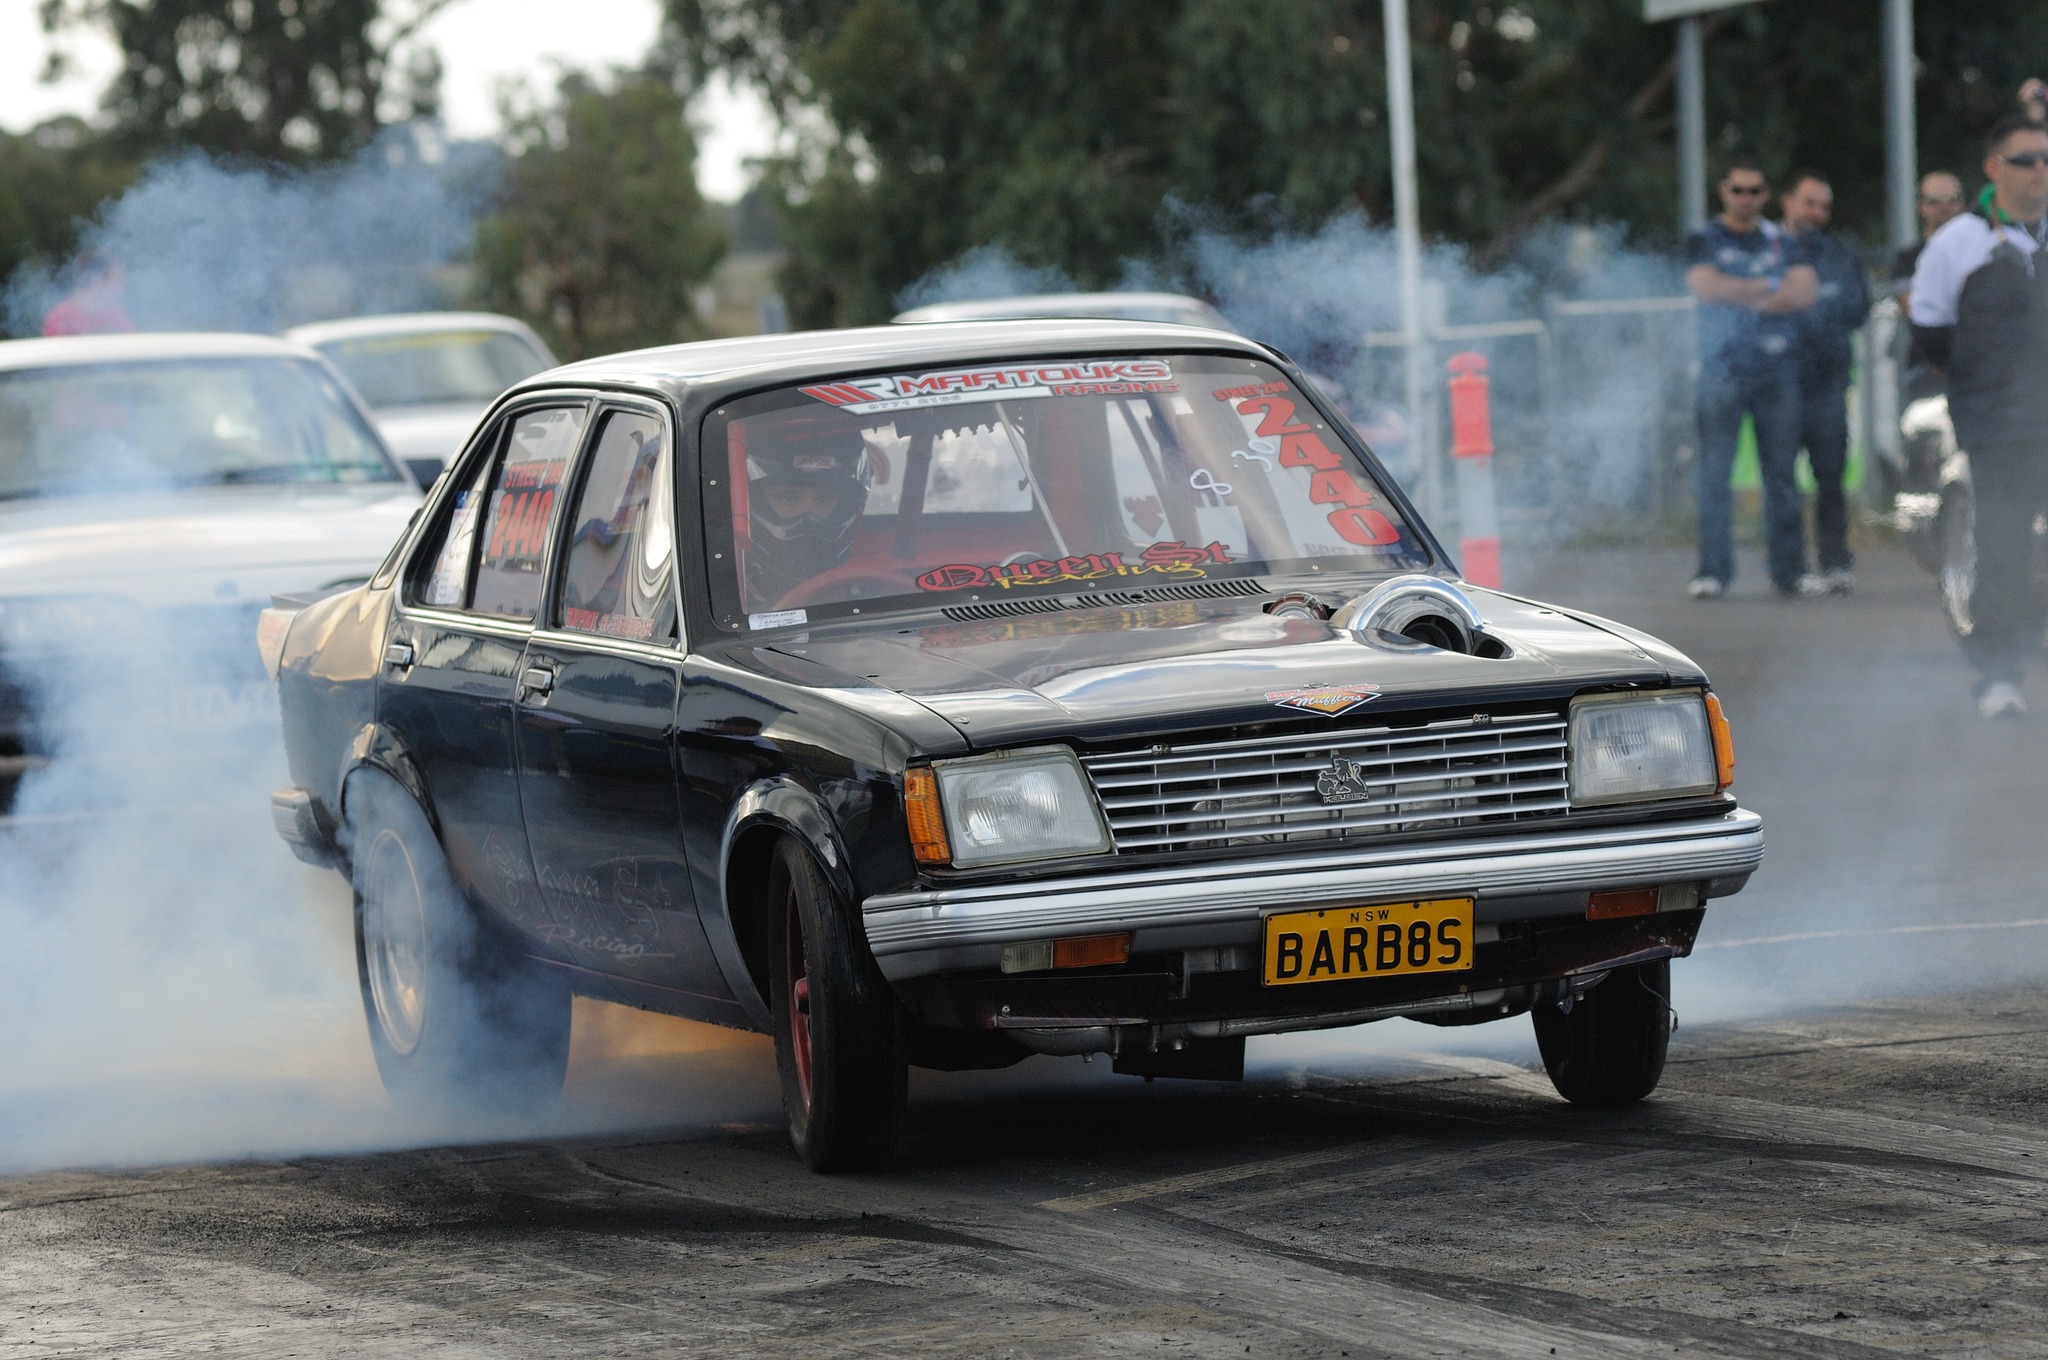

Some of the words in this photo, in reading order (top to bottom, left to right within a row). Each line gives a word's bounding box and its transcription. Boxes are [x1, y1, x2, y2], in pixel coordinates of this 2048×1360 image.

[901, 362, 1171, 394] MAATOUKS
[1054, 381, 1182, 397] RACING
[1212, 384, 1260, 401] STREET
[504, 459, 548, 490] STREET
[1236, 396, 1400, 547] 2440
[489, 489, 555, 558] 2440
[917, 550, 1126, 591] Queen
[1139, 540, 1234, 566] St
[996, 559, 1206, 590] Racing
[1292, 694, 1364, 707] Mufflers
[1323, 790, 1369, 804] HOLDEN
[1350, 909, 1390, 923] NSW
[1276, 917, 1462, 979] BARB8S
